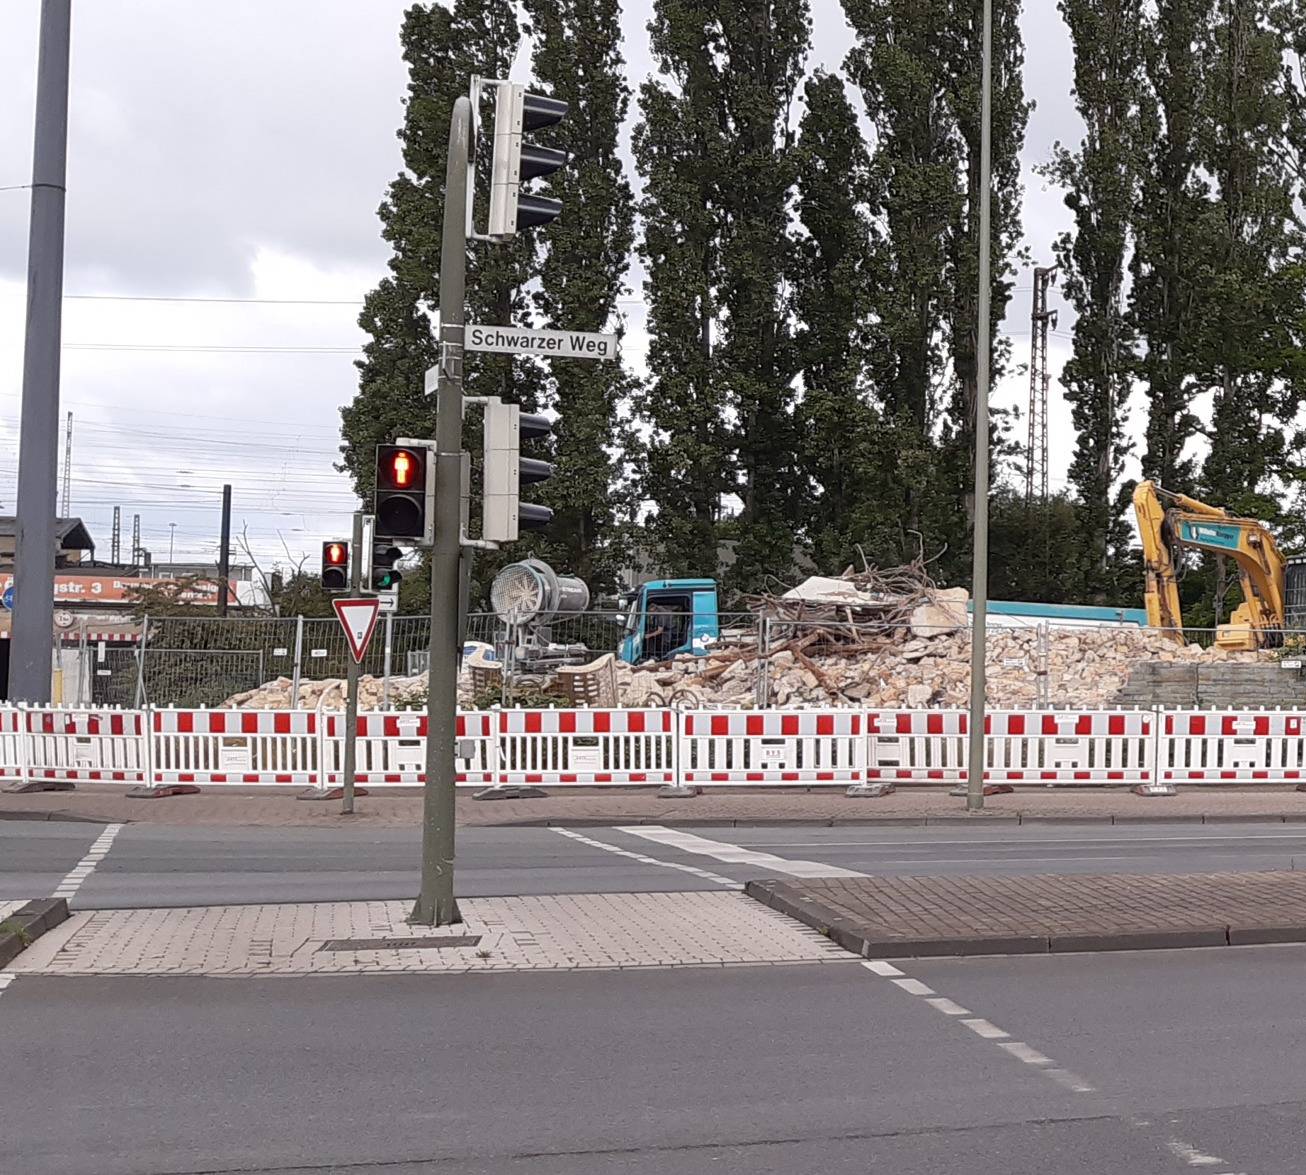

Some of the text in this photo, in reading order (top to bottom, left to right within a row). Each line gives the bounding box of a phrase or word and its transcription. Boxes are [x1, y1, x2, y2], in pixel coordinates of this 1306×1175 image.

[471, 329, 608, 356] Schwarzer Weg
[91, 582, 102, 594] 3
